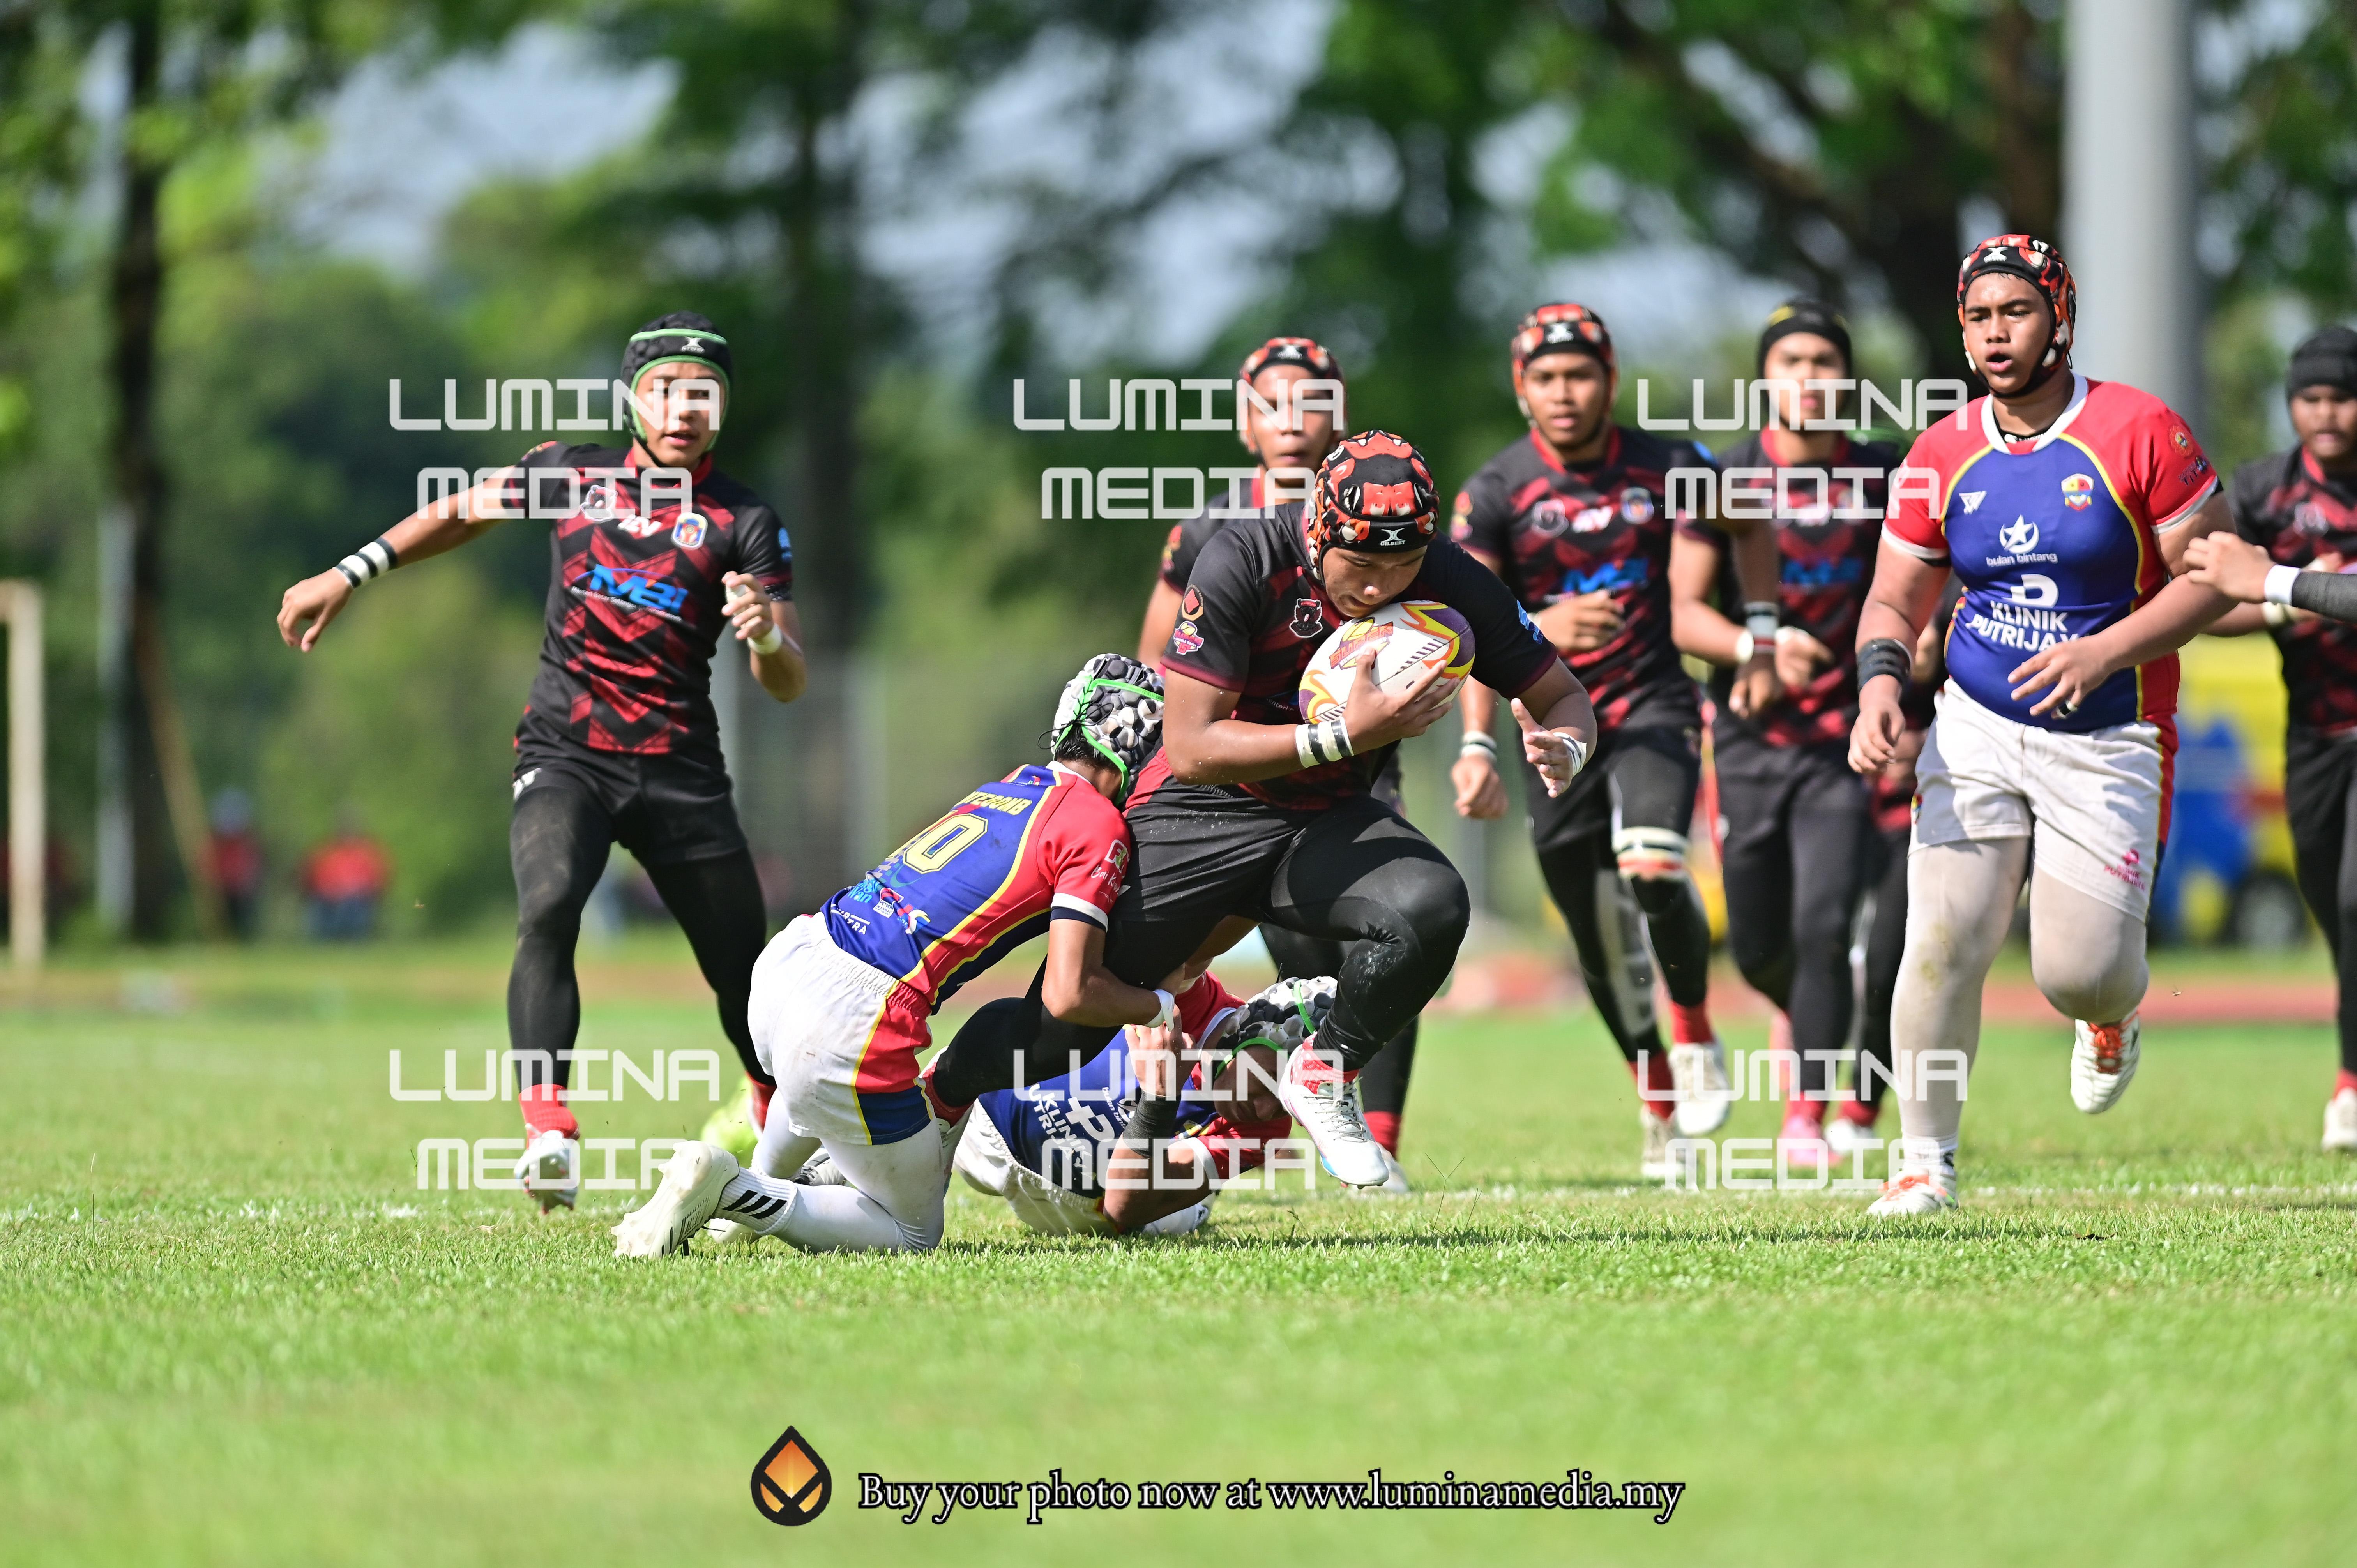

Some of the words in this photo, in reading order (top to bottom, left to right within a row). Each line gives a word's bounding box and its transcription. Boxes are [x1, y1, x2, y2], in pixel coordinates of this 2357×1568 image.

[1986, 556, 2016, 567] bulan
[2016, 553, 2058, 564] bintang
[1990, 600, 2068, 632] KLINIK
[1042, 1092, 1092, 1157] KLINIK
